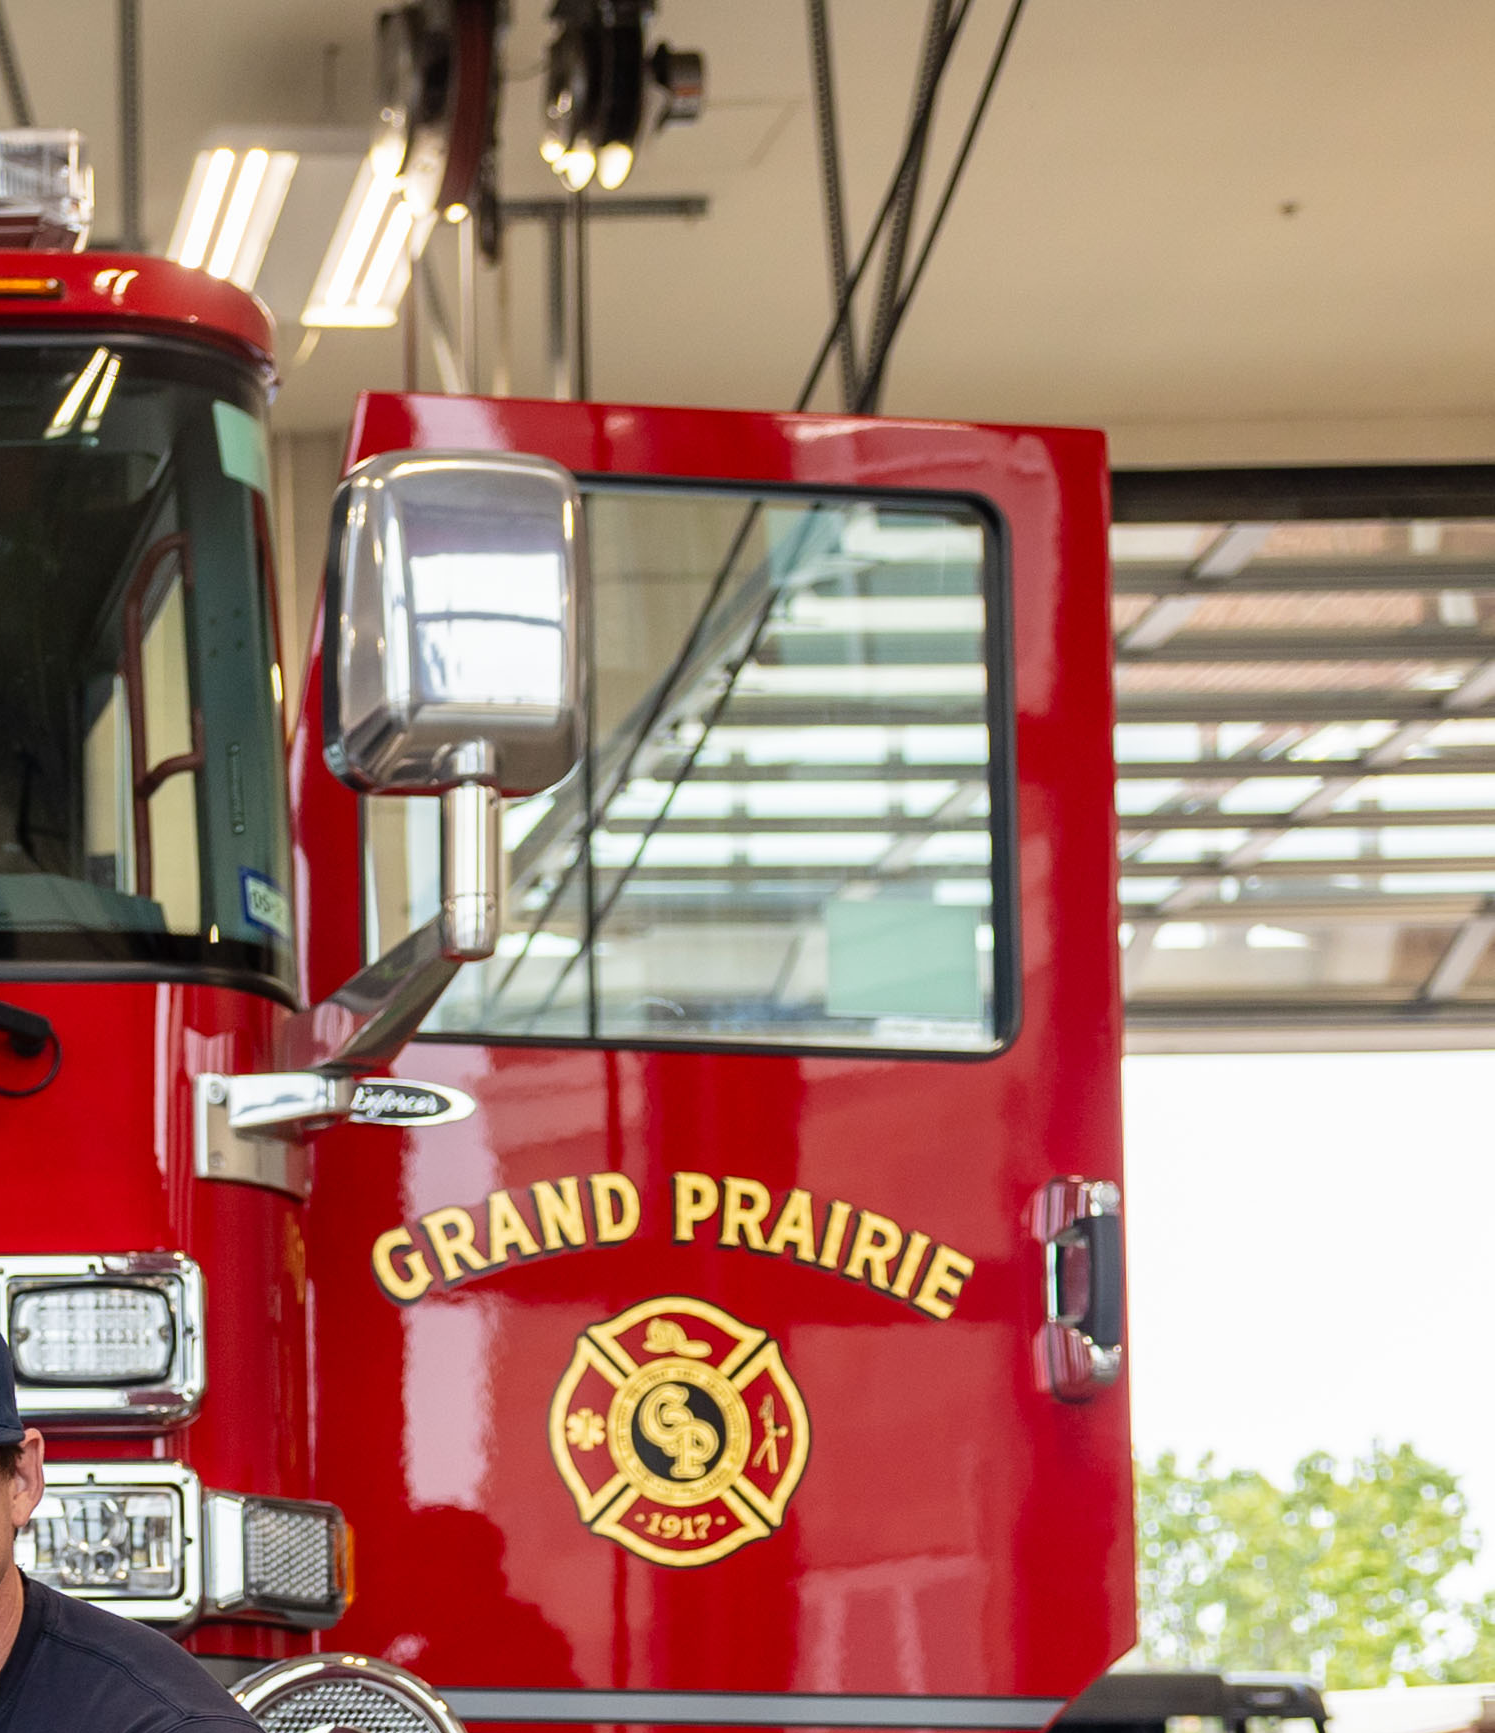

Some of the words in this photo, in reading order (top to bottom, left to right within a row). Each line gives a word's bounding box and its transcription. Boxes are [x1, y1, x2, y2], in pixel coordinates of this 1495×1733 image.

[372, 1171, 641, 1303] GRAND
[671, 1171, 975, 1321] PRAIRIE
[644, 1512, 712, 1541] 1917
